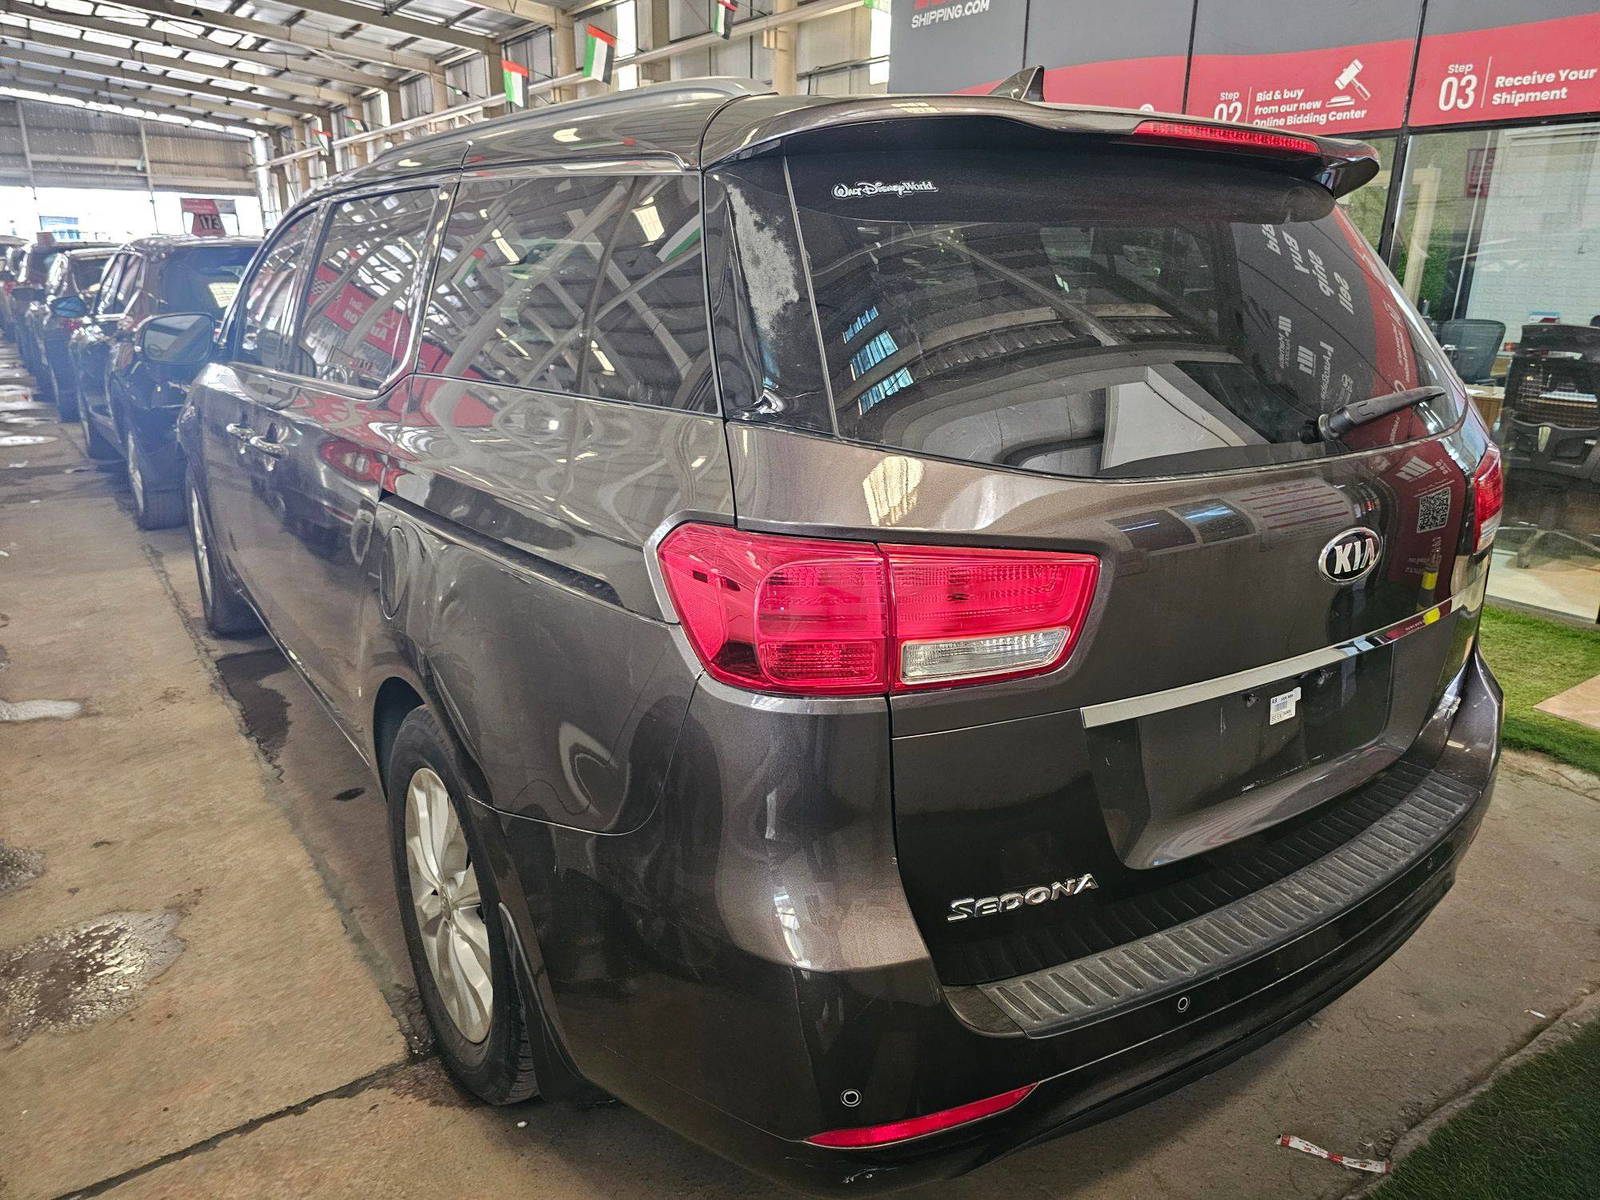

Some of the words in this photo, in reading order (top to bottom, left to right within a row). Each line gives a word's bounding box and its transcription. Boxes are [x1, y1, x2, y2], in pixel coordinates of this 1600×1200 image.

[911, 0, 990, 28] SHIPPING.COM
[1447, 63, 1474, 75] Step
[1495, 71, 1556, 88] Receive
[1559, 68, 1597, 82] Your
[1220, 92, 1240, 101] Step
[1256, 91, 1272, 102] Bid
[1274, 91, 1282, 101] &
[1284, 88, 1305, 100] buy
[1438, 75, 1478, 111] 03
[1492, 87, 1568, 107] Shipment
[1254, 105, 1279, 116] from
[1280, 104, 1298, 113] our
[1299, 100, 1323, 110] new
[1286, 113, 1327, 126] Bidding
[1329, 109, 1367, 121] Center
[1334, 538, 1376, 575] KIA
[947, 873, 1100, 921] SEDONA
